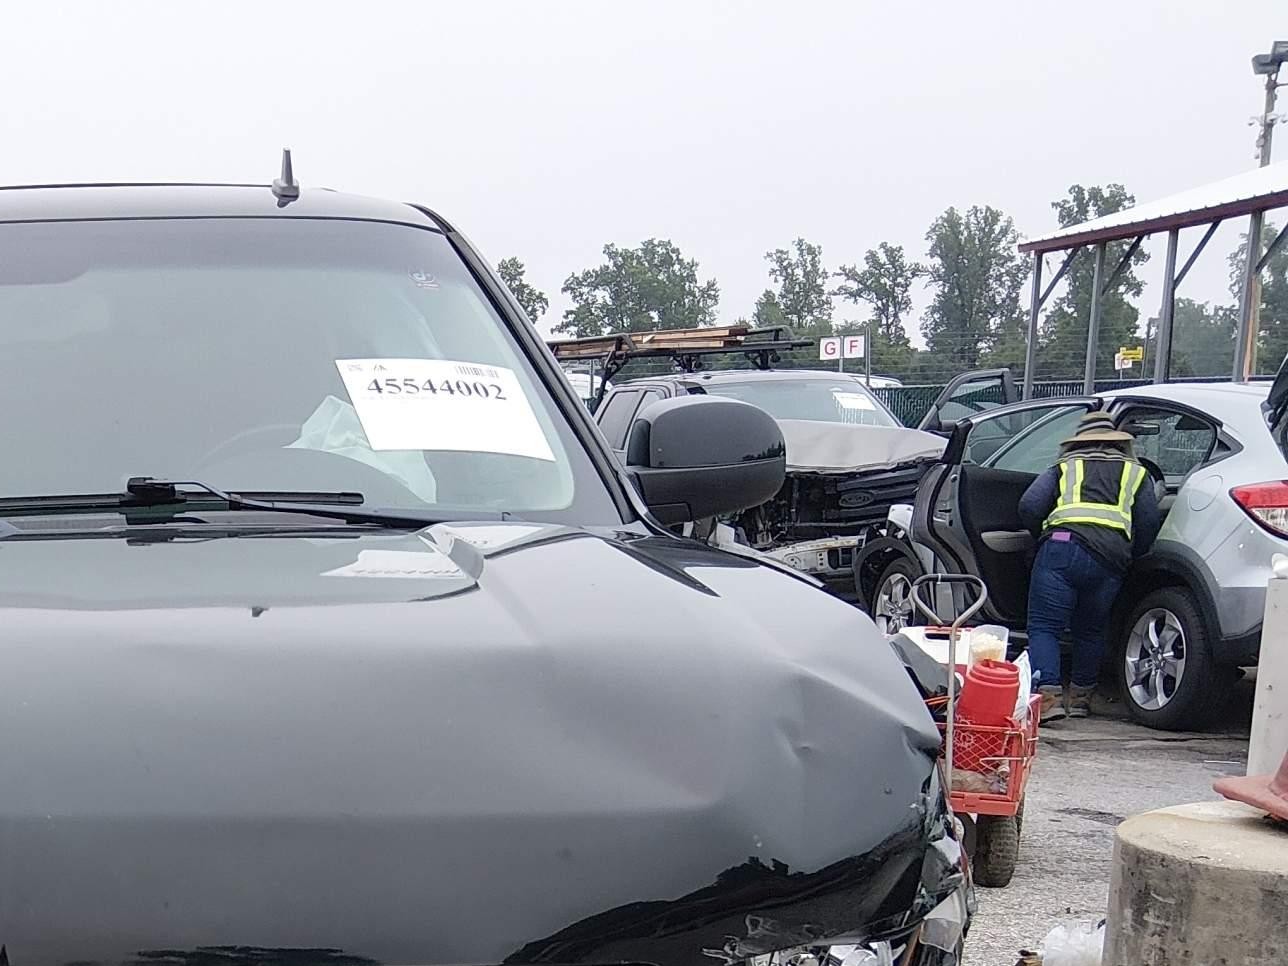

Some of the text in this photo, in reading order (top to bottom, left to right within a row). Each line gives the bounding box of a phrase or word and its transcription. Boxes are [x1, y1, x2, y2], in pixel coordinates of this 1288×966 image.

[824, 341, 837, 356] G
[849, 339, 859, 354] F
[367, 378, 507, 401] 45544002
